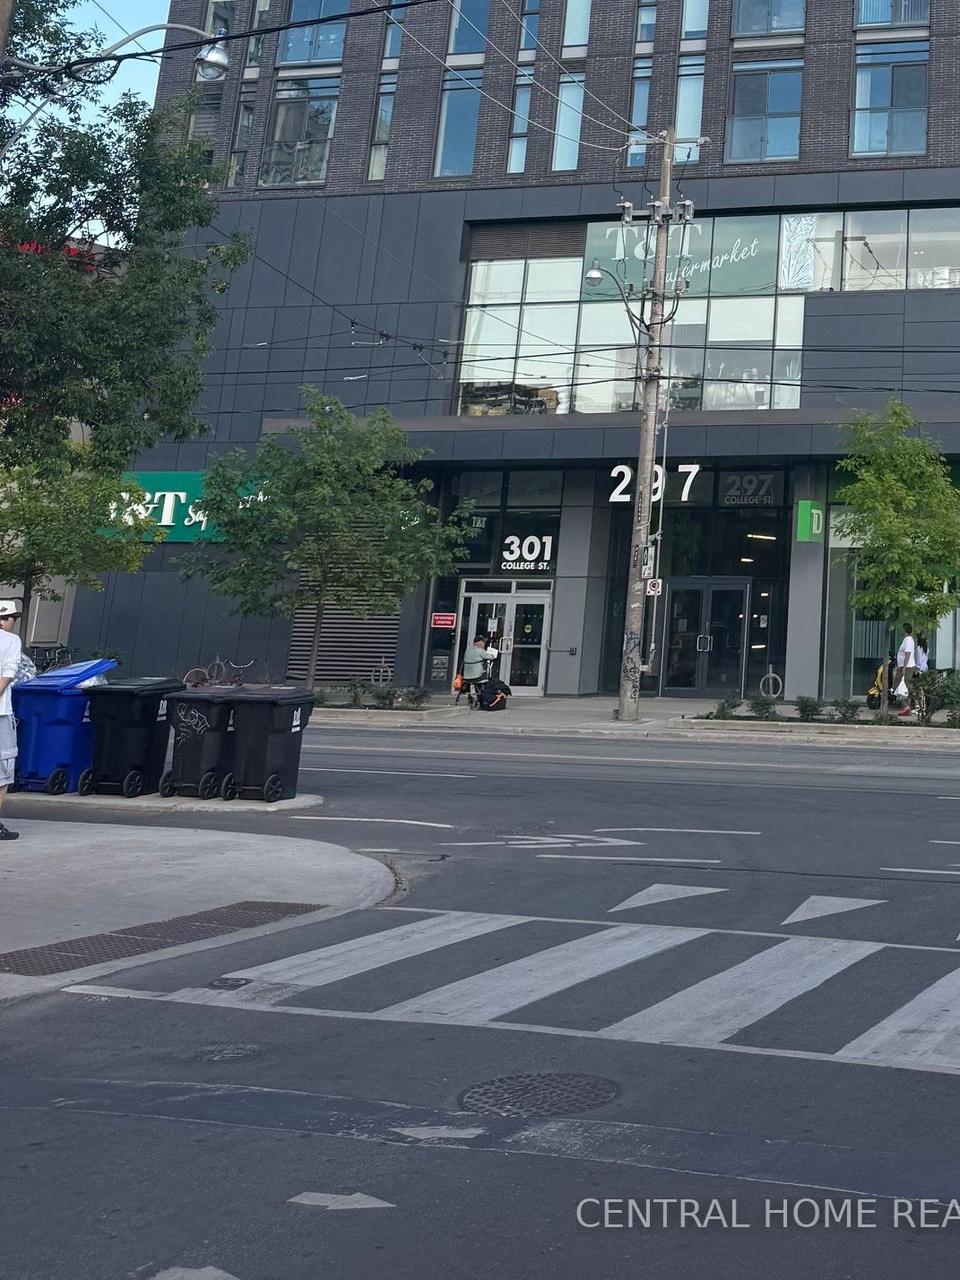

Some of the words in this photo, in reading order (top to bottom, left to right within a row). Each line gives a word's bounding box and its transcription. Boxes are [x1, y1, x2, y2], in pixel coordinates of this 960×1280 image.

[605, 224, 702, 261] T&T
[664, 238, 759, 291] upermarket
[608, 464, 700, 503] 297
[726, 474, 775, 496] 297
[724, 495, 761, 505] COLLEGE
[811, 508, 823, 534] TD
[502, 535, 553, 561] 301
[501, 561, 536, 570] COLLEGE
[538, 561, 550, 570] ST.
